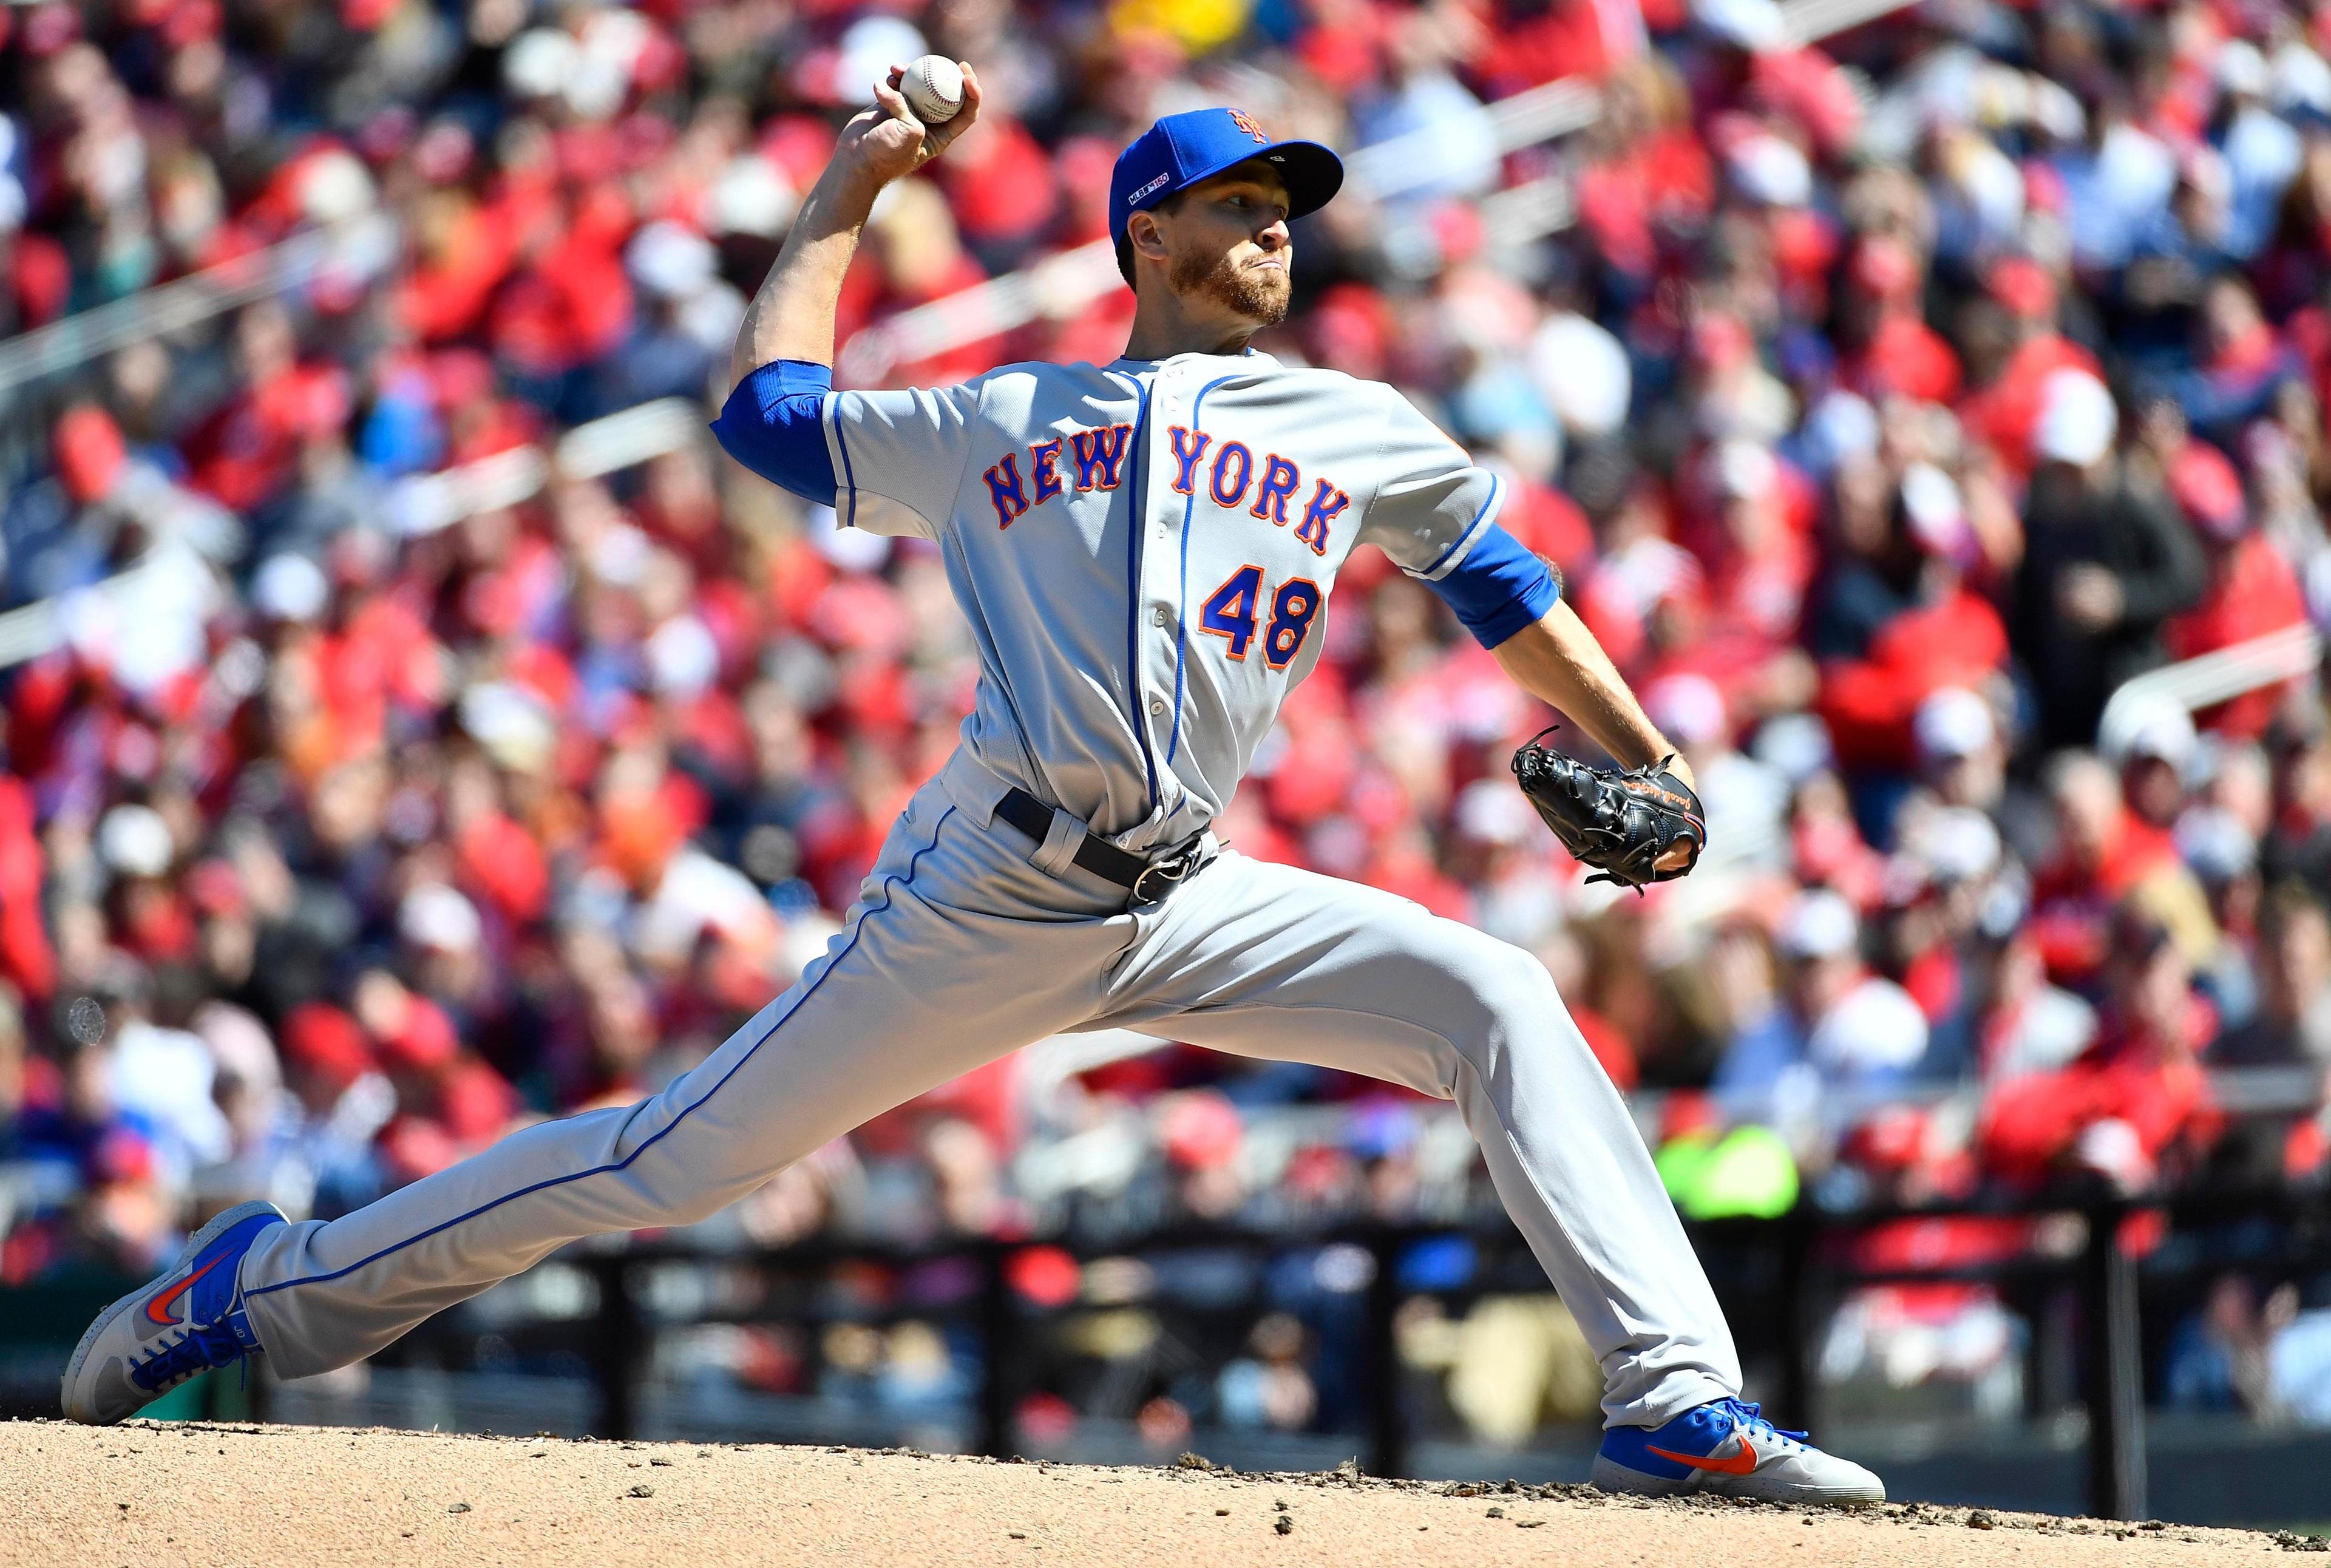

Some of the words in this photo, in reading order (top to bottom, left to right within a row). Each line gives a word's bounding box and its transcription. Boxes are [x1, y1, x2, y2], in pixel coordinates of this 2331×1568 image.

[1129, 189, 1144, 205] MLB
[1154, 174, 1168, 187] 150
[983, 423, 1133, 530] NEW
[1167, 424, 1351, 556] YORK
[1199, 564, 1323, 670] 48
[234, 1325, 245, 1338] JD
